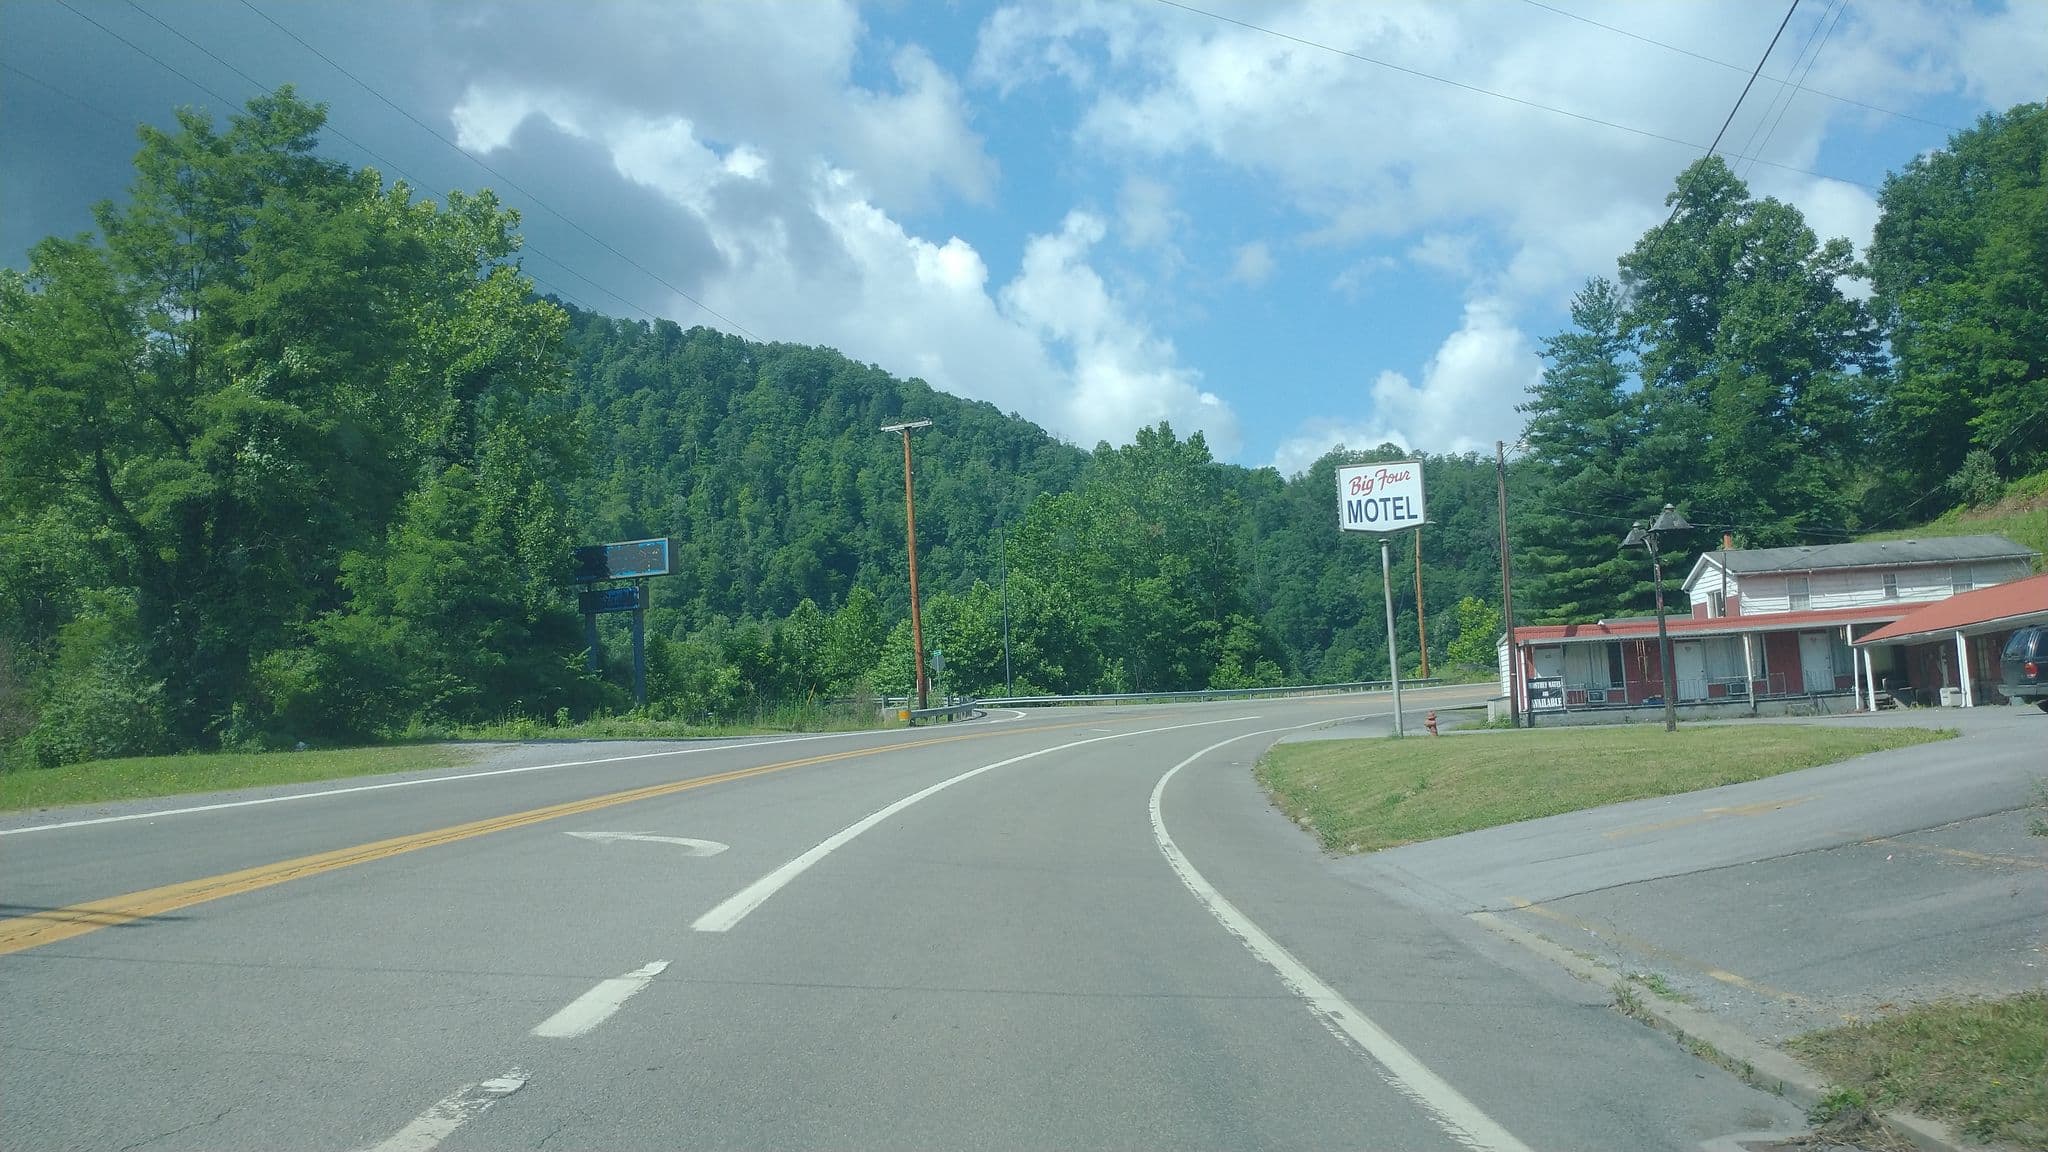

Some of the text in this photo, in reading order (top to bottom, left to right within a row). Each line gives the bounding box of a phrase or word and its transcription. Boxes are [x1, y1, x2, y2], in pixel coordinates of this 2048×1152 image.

[1349, 469, 1411, 496] Big Four
[1347, 496, 1418, 524] MOTEL
[1532, 698, 1562, 708] AVAILABLE
